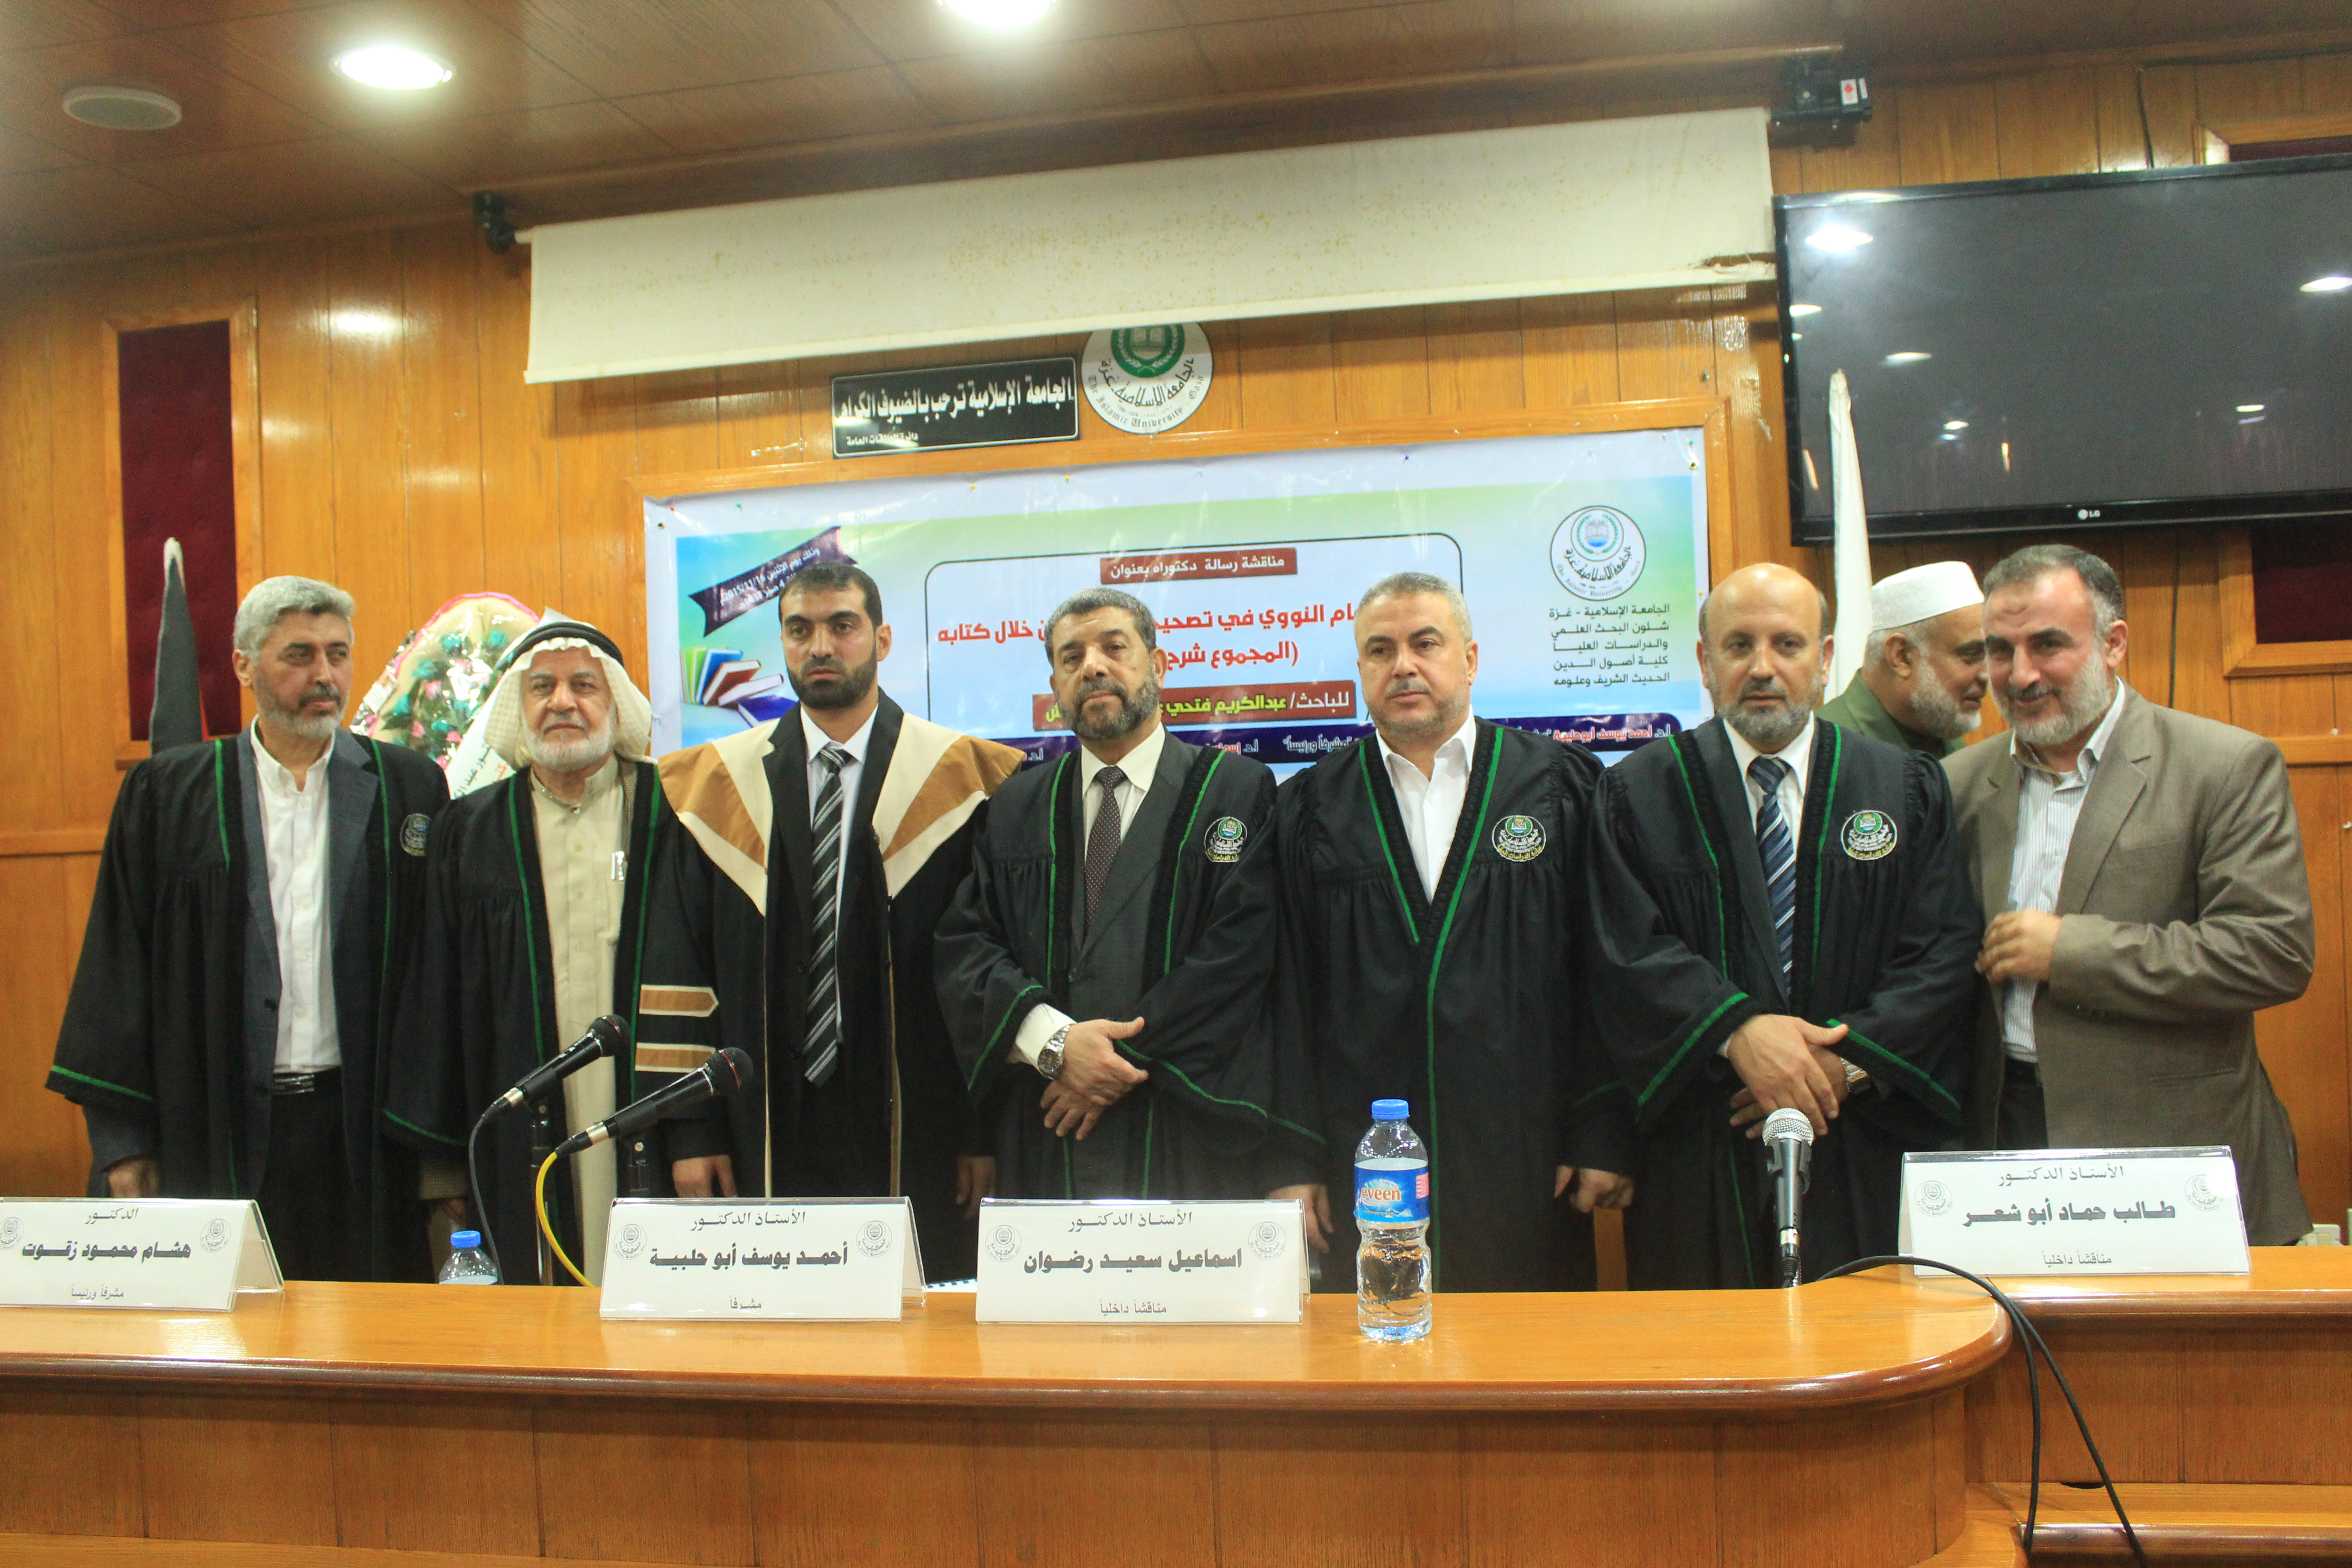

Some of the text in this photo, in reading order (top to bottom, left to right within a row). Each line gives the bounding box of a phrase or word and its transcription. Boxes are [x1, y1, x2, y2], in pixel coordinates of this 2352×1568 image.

[931, 382, 965, 420] ترحب
[968, 380, 1021, 415] الإسلامية
[1025, 375, 1074, 410] الجامعة
[1088, 375, 1098, 394] The
[1097, 395, 1128, 424] Islamic
[1132, 407, 1183, 427] University
[877, 387, 930, 424] بالضيوف
[846, 436, 868, 446] العامة
[1111, 556, 1285, 579] مناقشة رسالة دكتوراه بعنوان
[779, 579, 785, 588] 4
[1155, 610, 1214, 634] تصحي
[1218, 609, 1254, 631] في
[1259, 604, 1325, 629] النووي
[1549, 608, 1573, 621] غزة
[1584, 605, 1629, 619] الإسلامية
[1632, 604, 1670, 617] الجامعة
[938, 622, 991, 646] كتابه
[995, 620, 1034, 644] خلال
[1551, 620, 1669, 641] شئون البحث العلمي
[1553, 638, 1668, 654] والدراسات العليا
[1553, 653, 1669, 671] كلية أصول الدين
[1553, 672, 1670, 688] الحديث الشريف وعلومه
[1166, 697, 1211, 717] فتحي
[1214, 694, 1287, 715] عبدالكريم
[1289, 691, 1349, 713] للباحث/
[1597, 727, 1628, 742] يوسف
[1998, 1163, 2124, 1186] الأستاذ الدكتور
[84, 1207, 139, 1225] الدكتور
[691, 1208, 807, 1231] الأستاذ الدكتور
[1068, 1209, 1192, 1233] الأستاذ الدكتور
[1962, 1202, 2022, 1227] شعر
[2027, 1197, 2053, 1226] أبو
[2058, 1202, 2107, 1221] حماد
[2112, 1200, 2176, 1224] طالب
[21, 1241, 78, 1261] زقوت
[82, 1245, 138, 1261] محمود
[141, 1241, 192, 1264] هشام
[649, 1248, 708, 1271] حلبية
[711, 1243, 737, 1270] أبو
[741, 1247, 791, 1270] يوسف
[796, 1241, 848, 1267] أحمد
[1024, 1249, 1094, 1274] رضوان
[1168, 1248, 1243, 1273] اسماعيل
[2042, 1250, 2112, 1268] مناقشاً داخلياً
[1099, 1252, 1162, 1274] سعيد
[729, 1295, 762, 1310] مشرفاً
[1099, 1298, 1167, 1317] مناقشاً داخلياً
